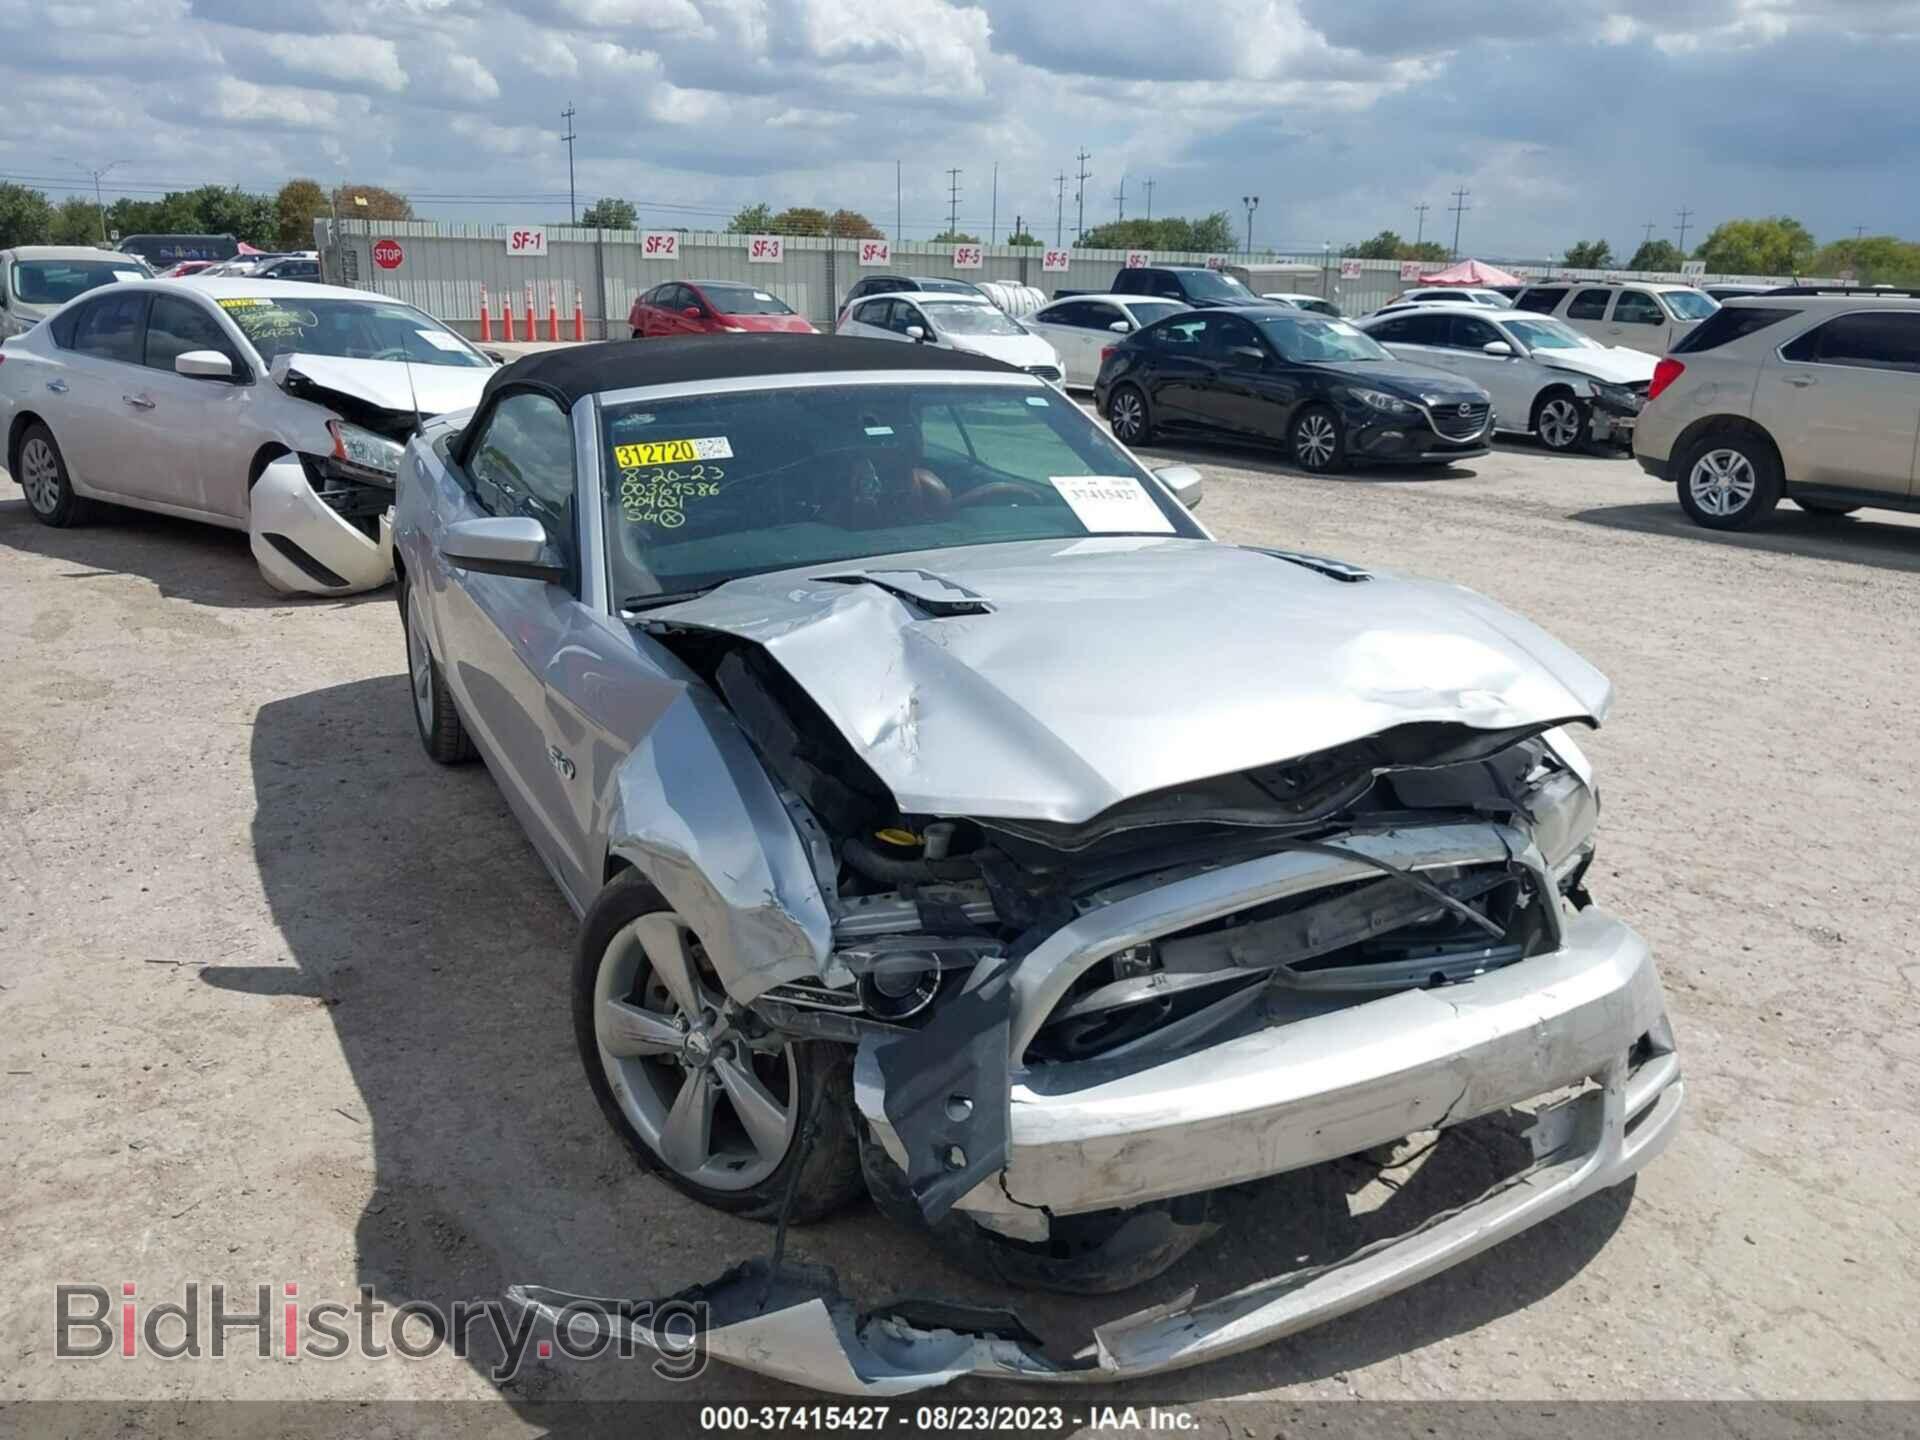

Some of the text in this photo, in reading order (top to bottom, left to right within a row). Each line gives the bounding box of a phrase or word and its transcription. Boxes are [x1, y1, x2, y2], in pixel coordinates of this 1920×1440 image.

[512, 231, 541, 249] SF-1
[645, 235, 675, 254] SF-2
[752, 240, 779, 258] SF-3
[375, 248, 401, 261] STOP
[863, 244, 888, 262] SF-4
[956, 248, 981, 265] SF-5
[1044, 251, 1068, 267] SF-6
[618, 441, 695, 466] 312720
[621, 464, 725, 483] 8-20-23
[620, 482, 720, 497] 00369586
